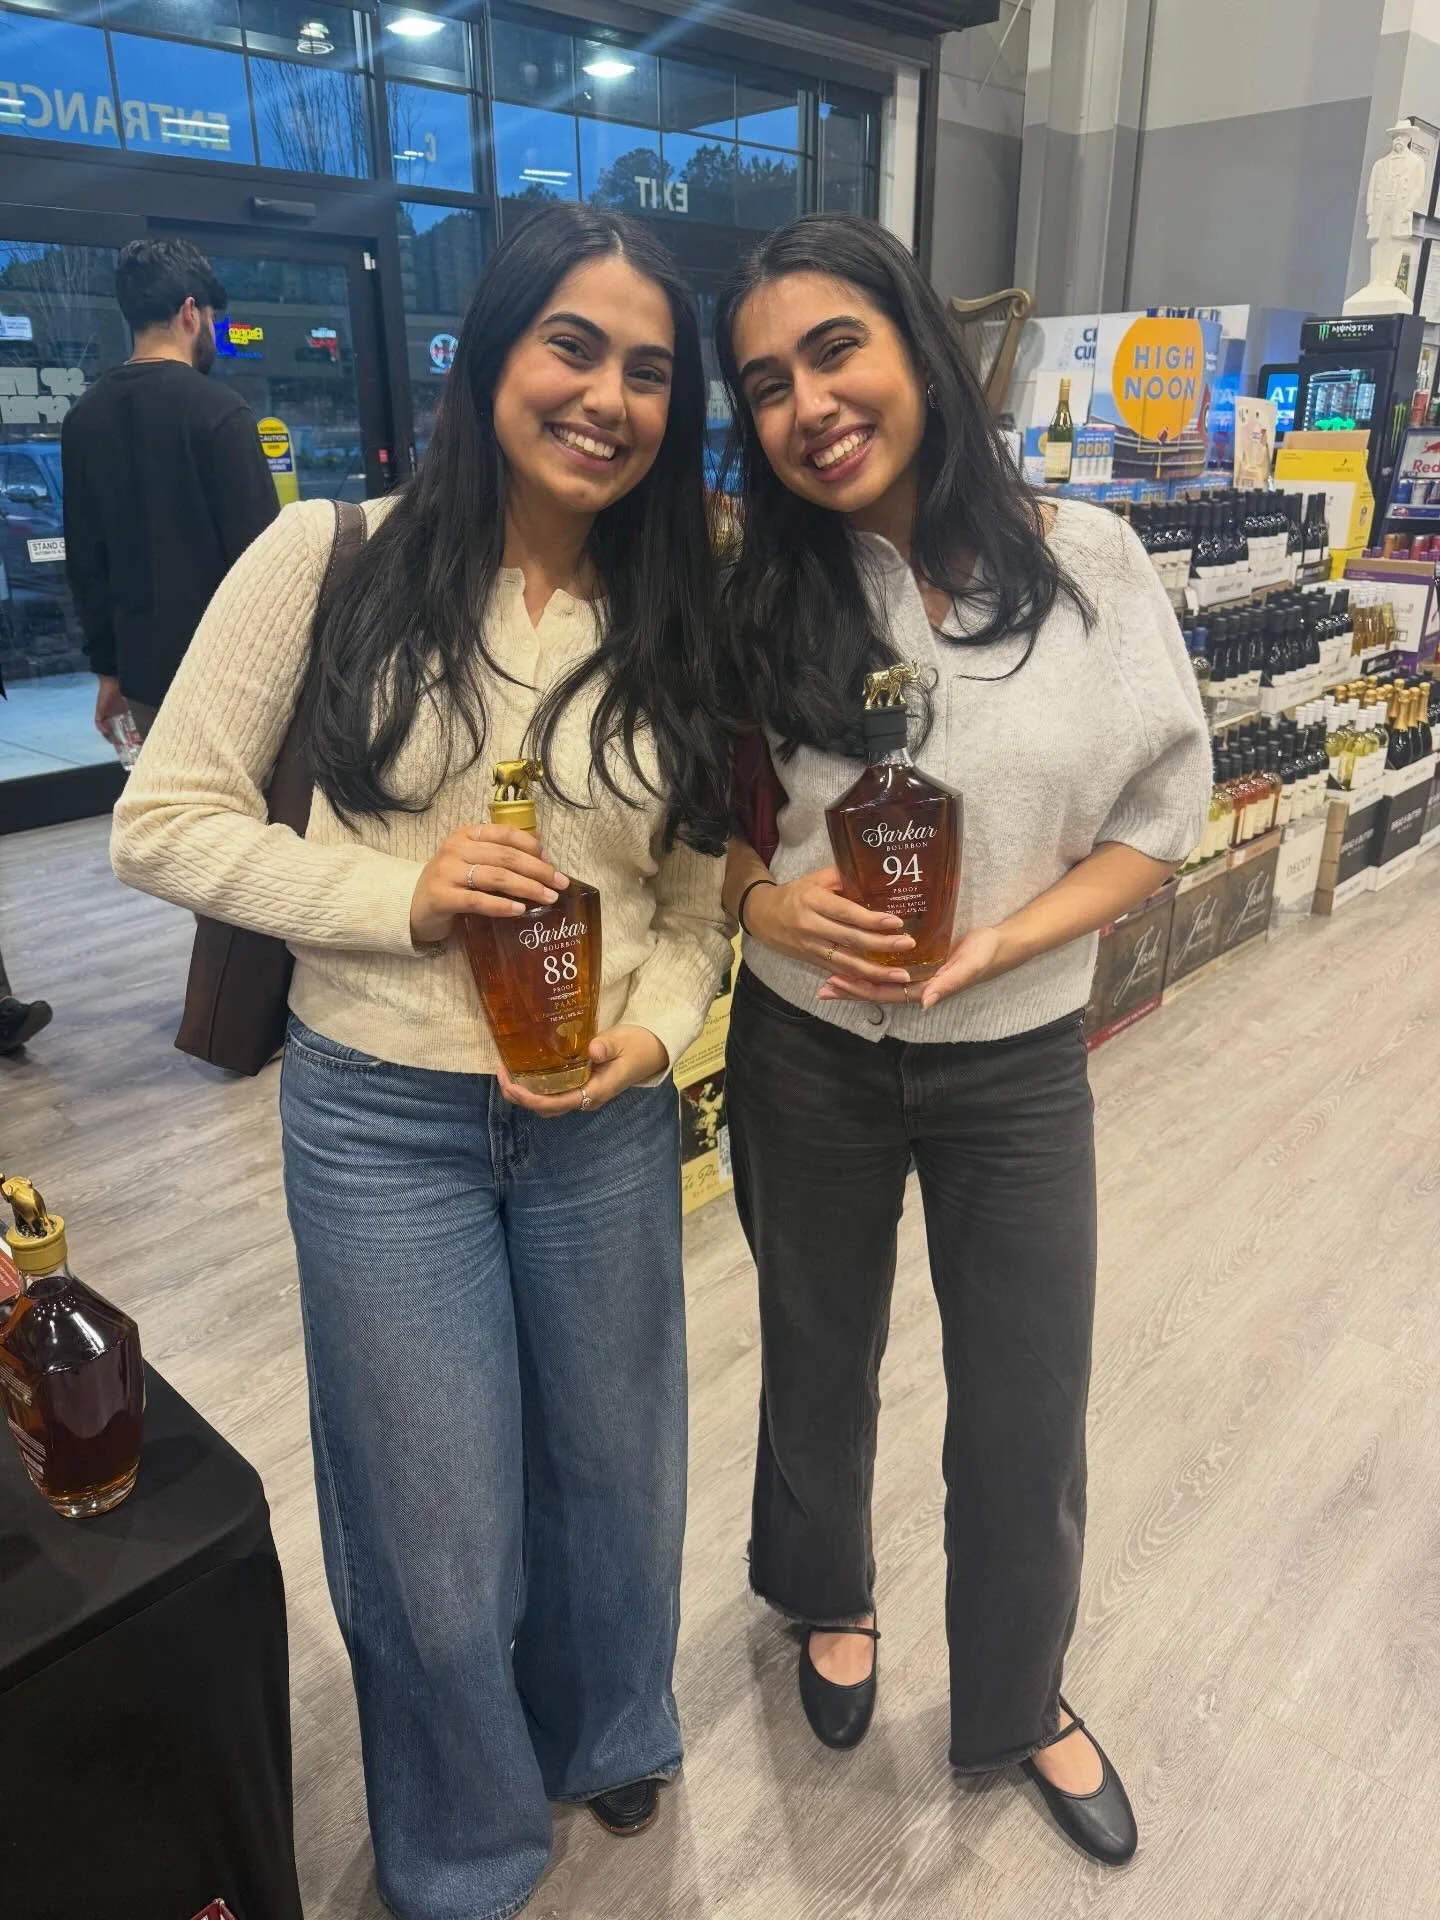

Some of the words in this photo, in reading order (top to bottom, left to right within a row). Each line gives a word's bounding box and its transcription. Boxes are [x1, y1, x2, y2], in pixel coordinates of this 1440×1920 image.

[1331, 324, 1374, 333] MONSTER
[1134, 345, 1196, 370] HIGH
[1124, 376, 1196, 400] NOON
[1270, 386, 1298, 403] AT
[31, 542, 58, 551] STAND
[861, 819, 938, 848] Sarkar
[886, 841, 928, 851] BOURBON
[882, 853, 923, 886] 94
[519, 917, 588, 950] Sarkar
[543, 939, 581, 952] BOURBON
[543, 952, 578, 984] 88
[553, 983, 574, 993] PROOF
